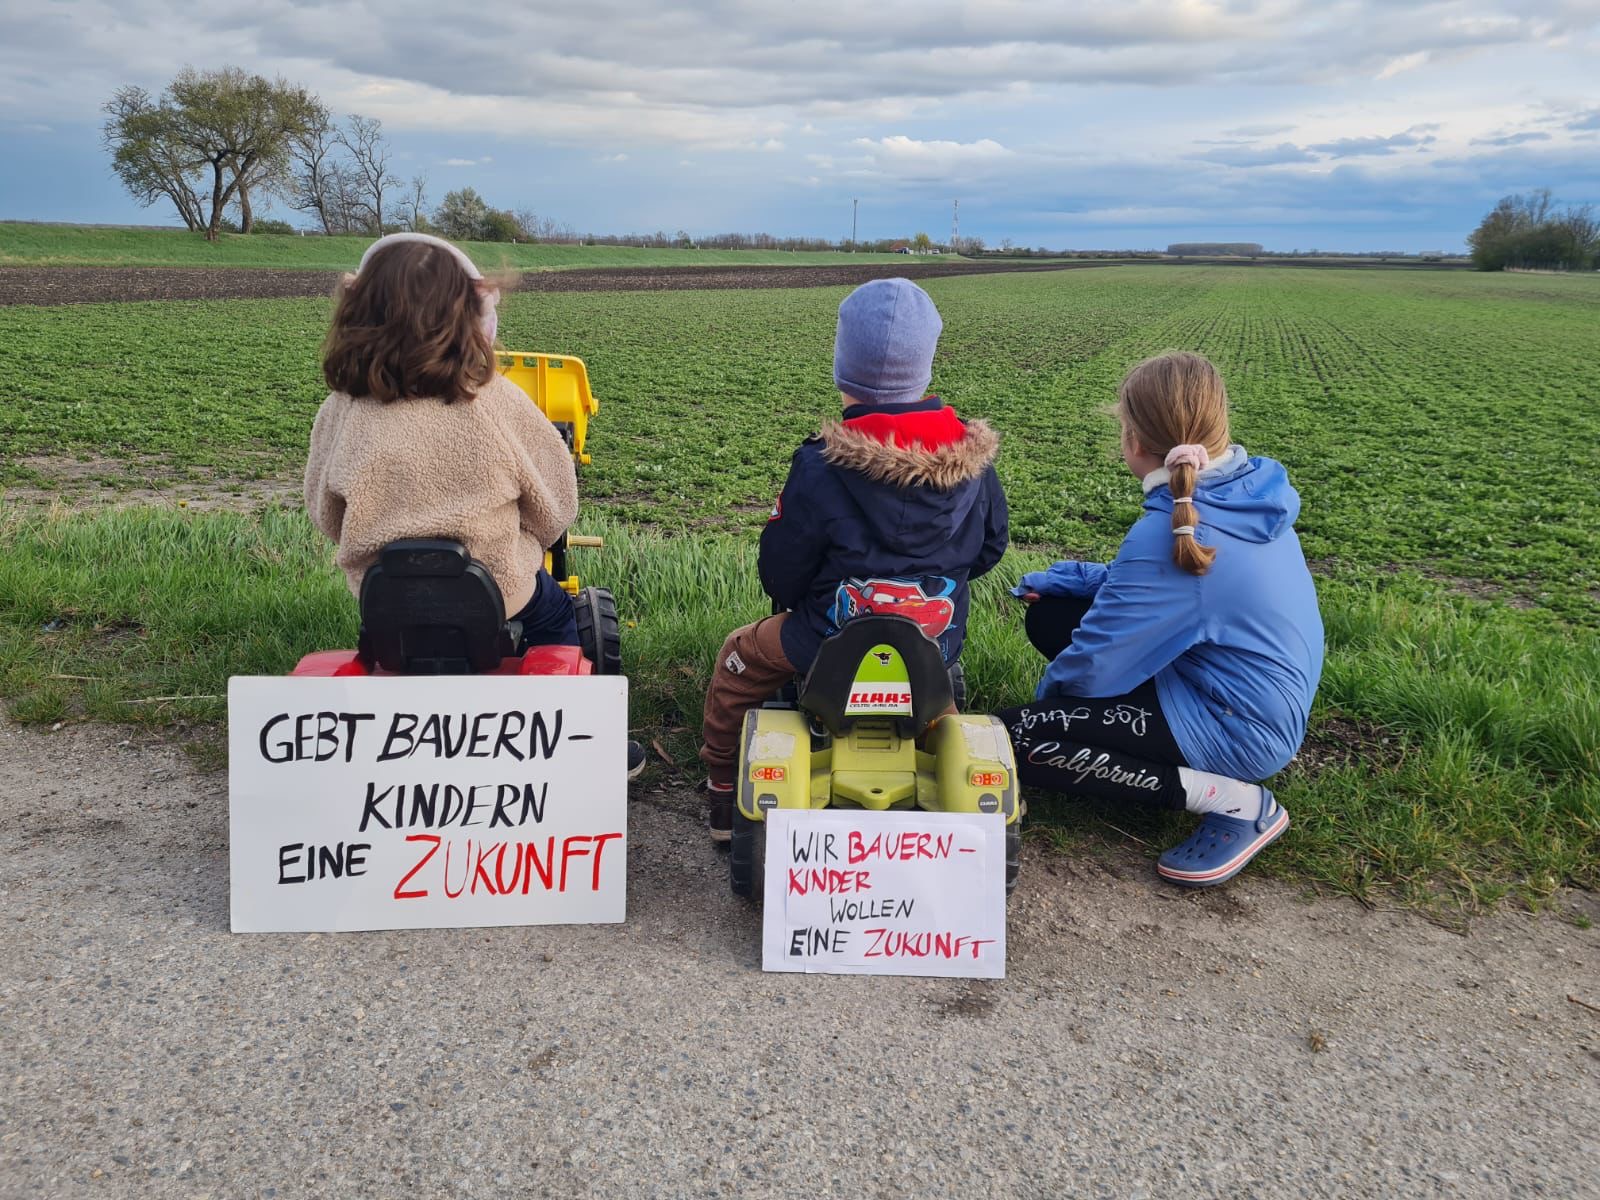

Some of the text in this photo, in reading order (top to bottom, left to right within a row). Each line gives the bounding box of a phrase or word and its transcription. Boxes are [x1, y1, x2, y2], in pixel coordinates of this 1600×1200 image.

[850, 693, 911, 703] CLAAS
[259, 711, 375, 763] GEBT
[1028, 741, 1161, 791] California
[359, 782, 548, 832] KINDERN
[792, 829, 838, 864] WIR
[278, 833, 623, 899] EINE ZUKUNFT
[788, 867, 872, 896] KINDER
[830, 897, 914, 923] WOLLEN
[789, 927, 997, 959] EINE ZUKUNFT
